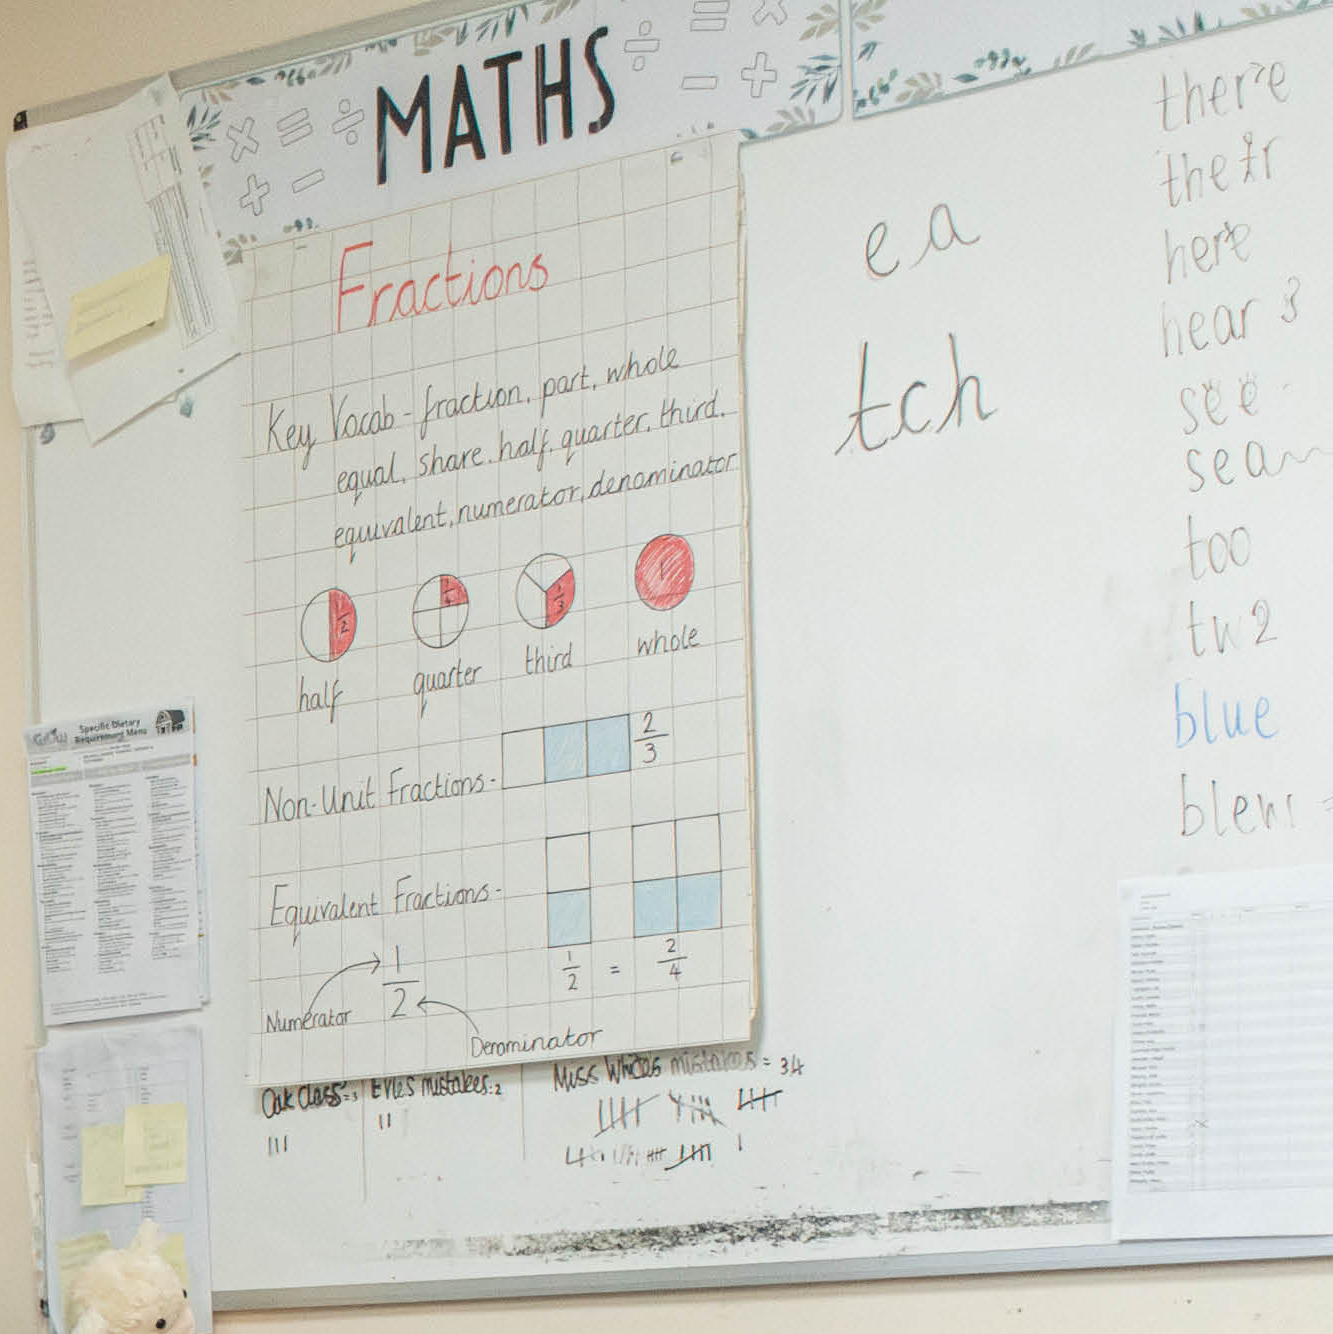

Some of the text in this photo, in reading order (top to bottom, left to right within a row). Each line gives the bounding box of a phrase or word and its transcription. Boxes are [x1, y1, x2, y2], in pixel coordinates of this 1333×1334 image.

[375, 26, 616, 186] MATHS
[1154, 60, 1290, 131] there
[336, 240, 549, 334] Fractions
[1162, 298, 1260, 359] hear
[266, 402, 316, 470] Key
[330, 392, 396, 442] Vocab
[607, 345, 681, 387] whole
[835, 332, 998, 456] tch
[589, 451, 739, 498] denominator
[1184, 514, 1252, 581] too
[526, 643, 574, 675] third
[637, 625, 701, 657] whole
[299, 675, 343, 725] half
[413, 662, 482, 721] quarter
[1175, 681, 1279, 750] blue
[641, 711, 653, 735] 2
[644, 743, 657, 764] 3
[270, 883, 380, 946] Equivalent
[391, 988, 407, 1019] 2
[567, 974, 579, 991] 2
[266, 1008, 352, 1034] Numerator
[471, 1027, 603, 1058] Denominator
[553, 1063, 598, 1093] Miss
[262, 1087, 295, 1119] Oak
